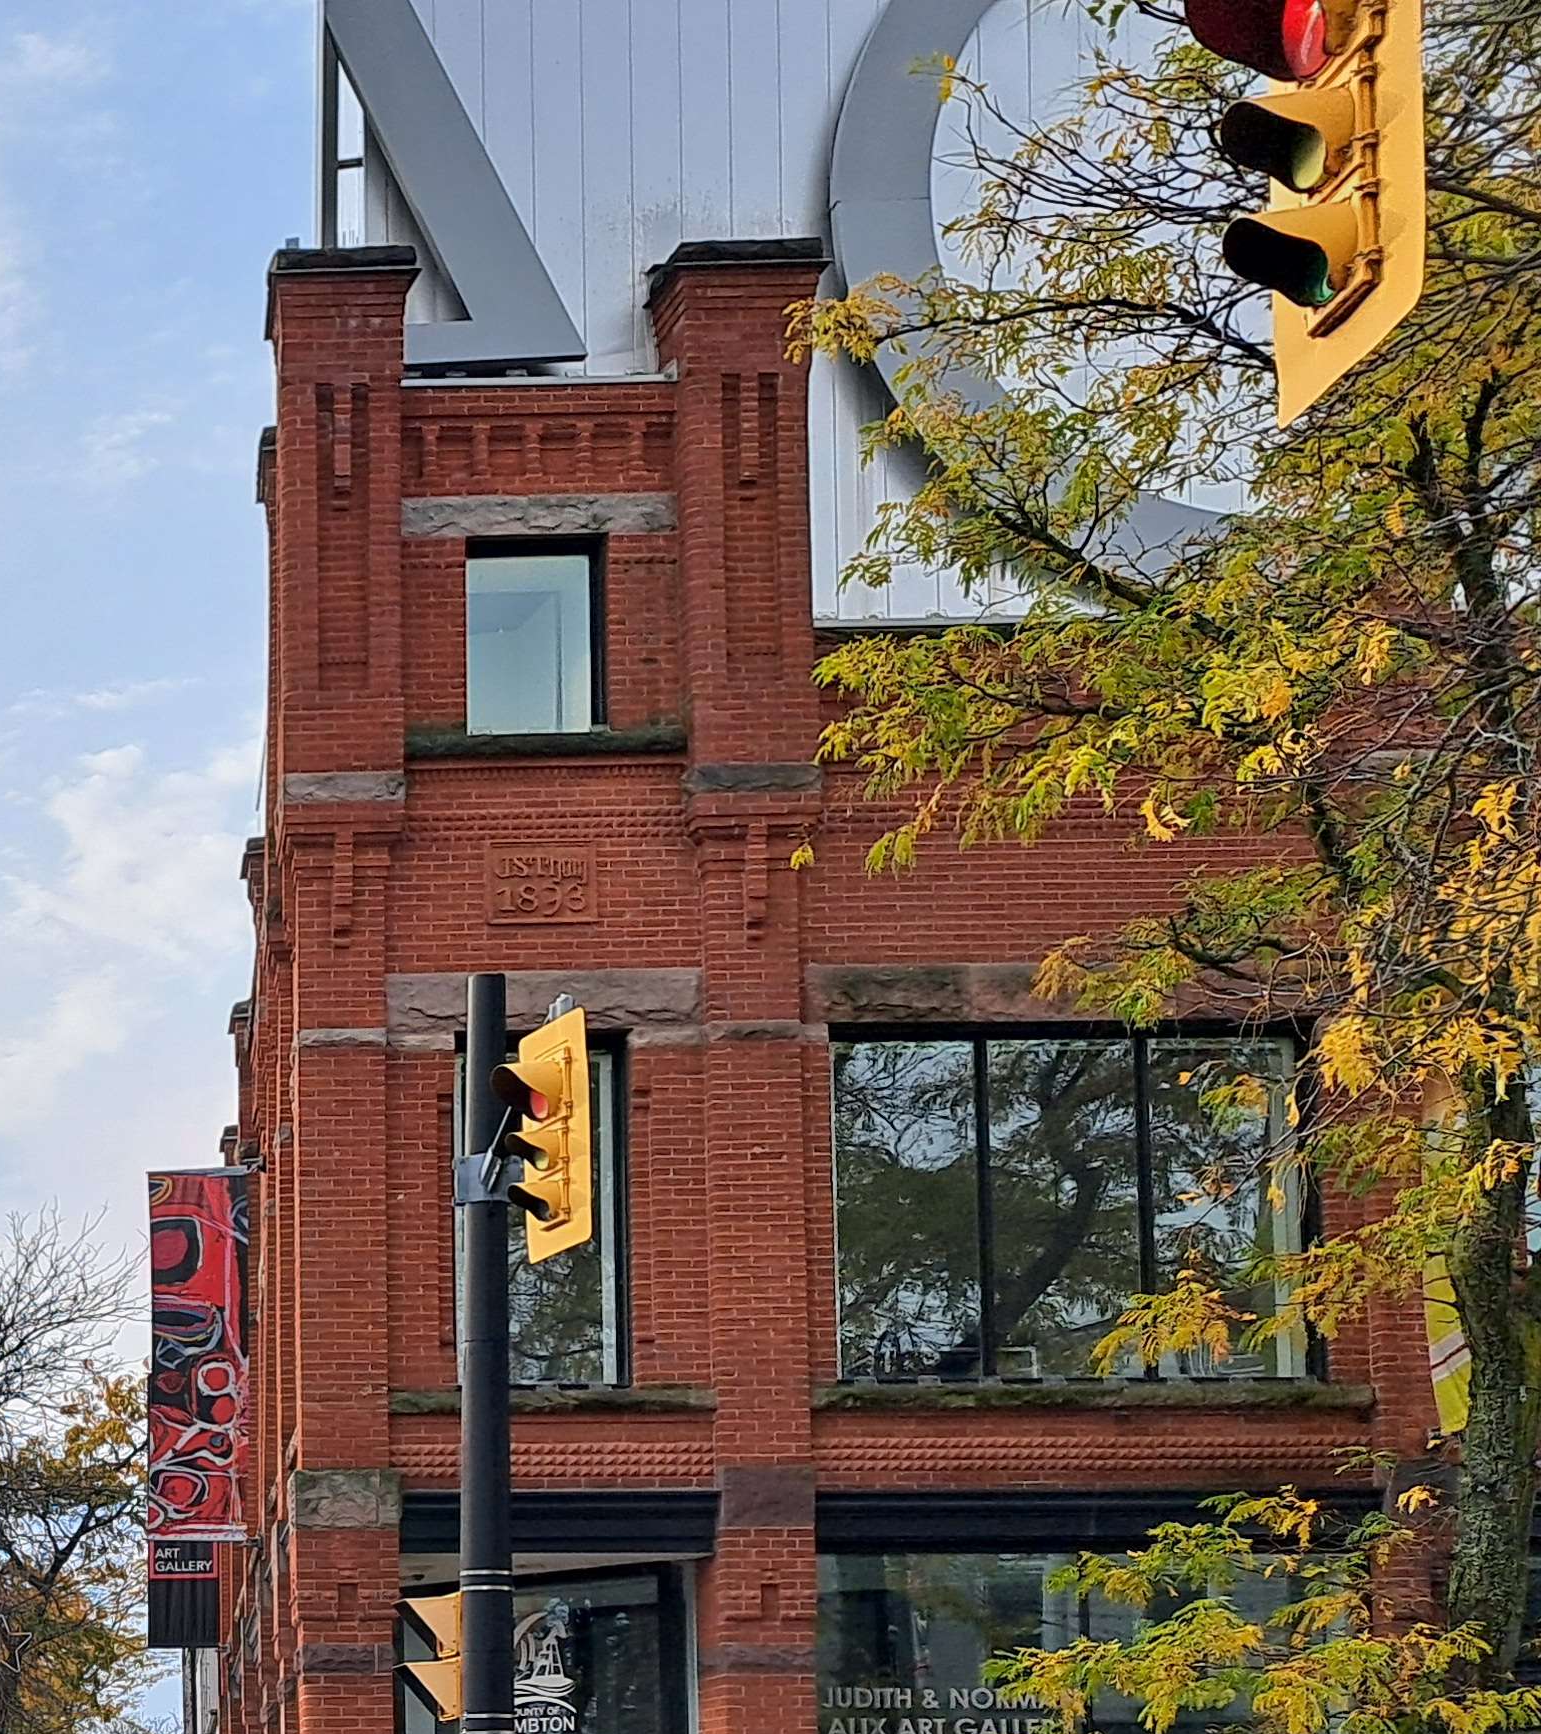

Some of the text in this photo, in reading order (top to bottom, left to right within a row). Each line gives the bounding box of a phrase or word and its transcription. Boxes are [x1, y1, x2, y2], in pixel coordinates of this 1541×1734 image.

[154, 1547, 181, 1559] ART
[154, 1560, 213, 1572] GALLERY
[821, 1686, 1049, 1710] JUDITH & NORM
[514, 1706, 546, 1717] UNTY
[514, 1715, 576, 1734] MBTON
